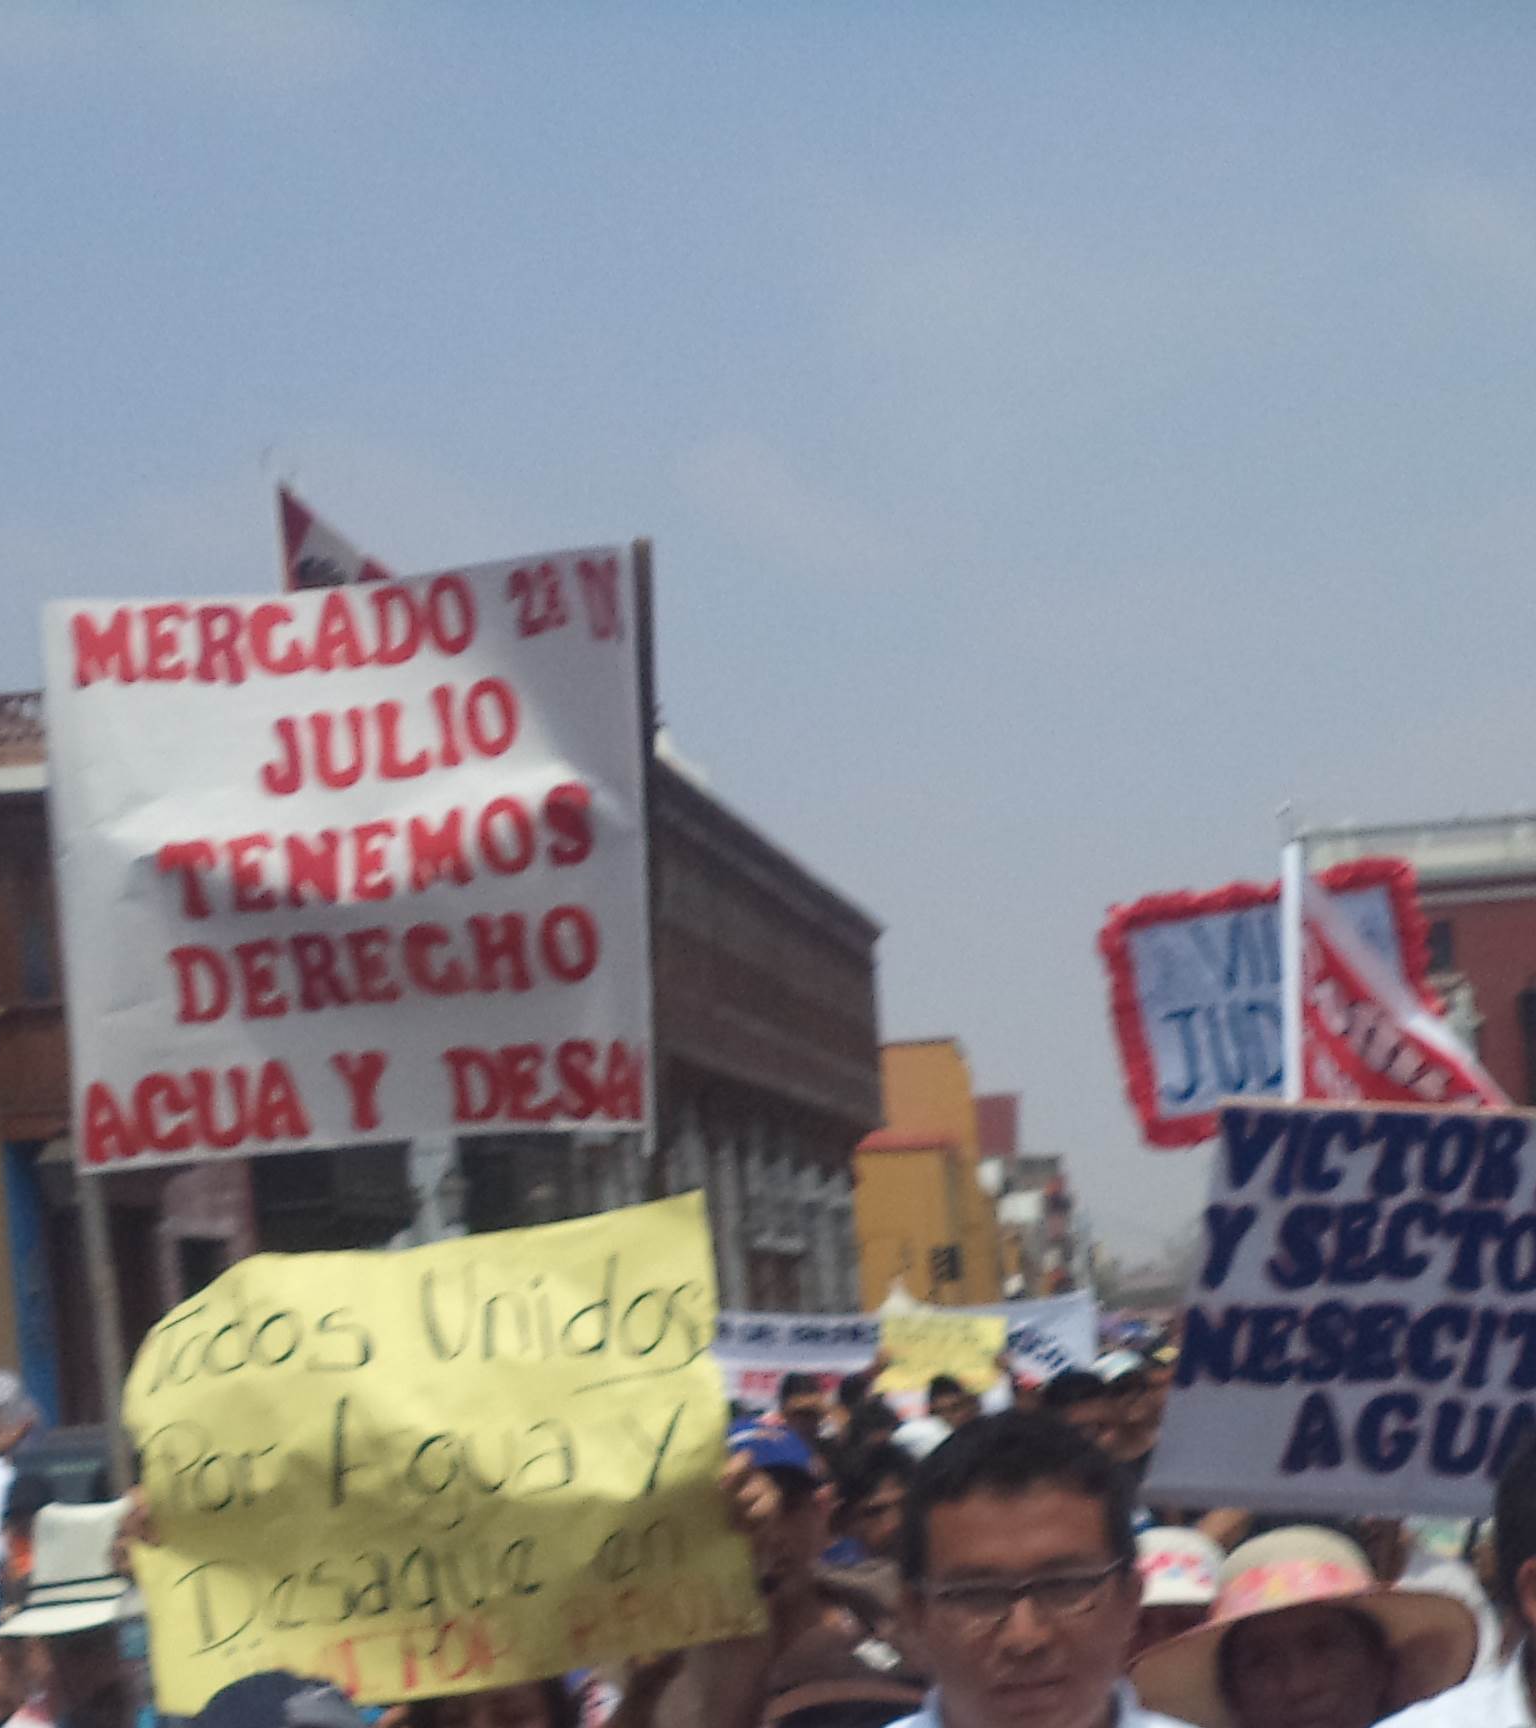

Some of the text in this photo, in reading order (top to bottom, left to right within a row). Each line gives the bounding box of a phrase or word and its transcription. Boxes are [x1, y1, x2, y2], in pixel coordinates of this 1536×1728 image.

[69, 574, 476, 690] MERCADO
[259, 676, 520, 796] JULIO
[155, 781, 594, 921] TENEMOS
[169, 904, 601, 1027] DERECHO
[330, 1051, 388, 1132] Y
[1220, 1110, 1530, 1203] VICTOR
[1200, 1203, 1257, 1292] Y
[147, 1253, 706, 1396] Todos Unidos
[134, 1419, 280, 1512] Por
[328, 1394, 576, 1530] Agua
